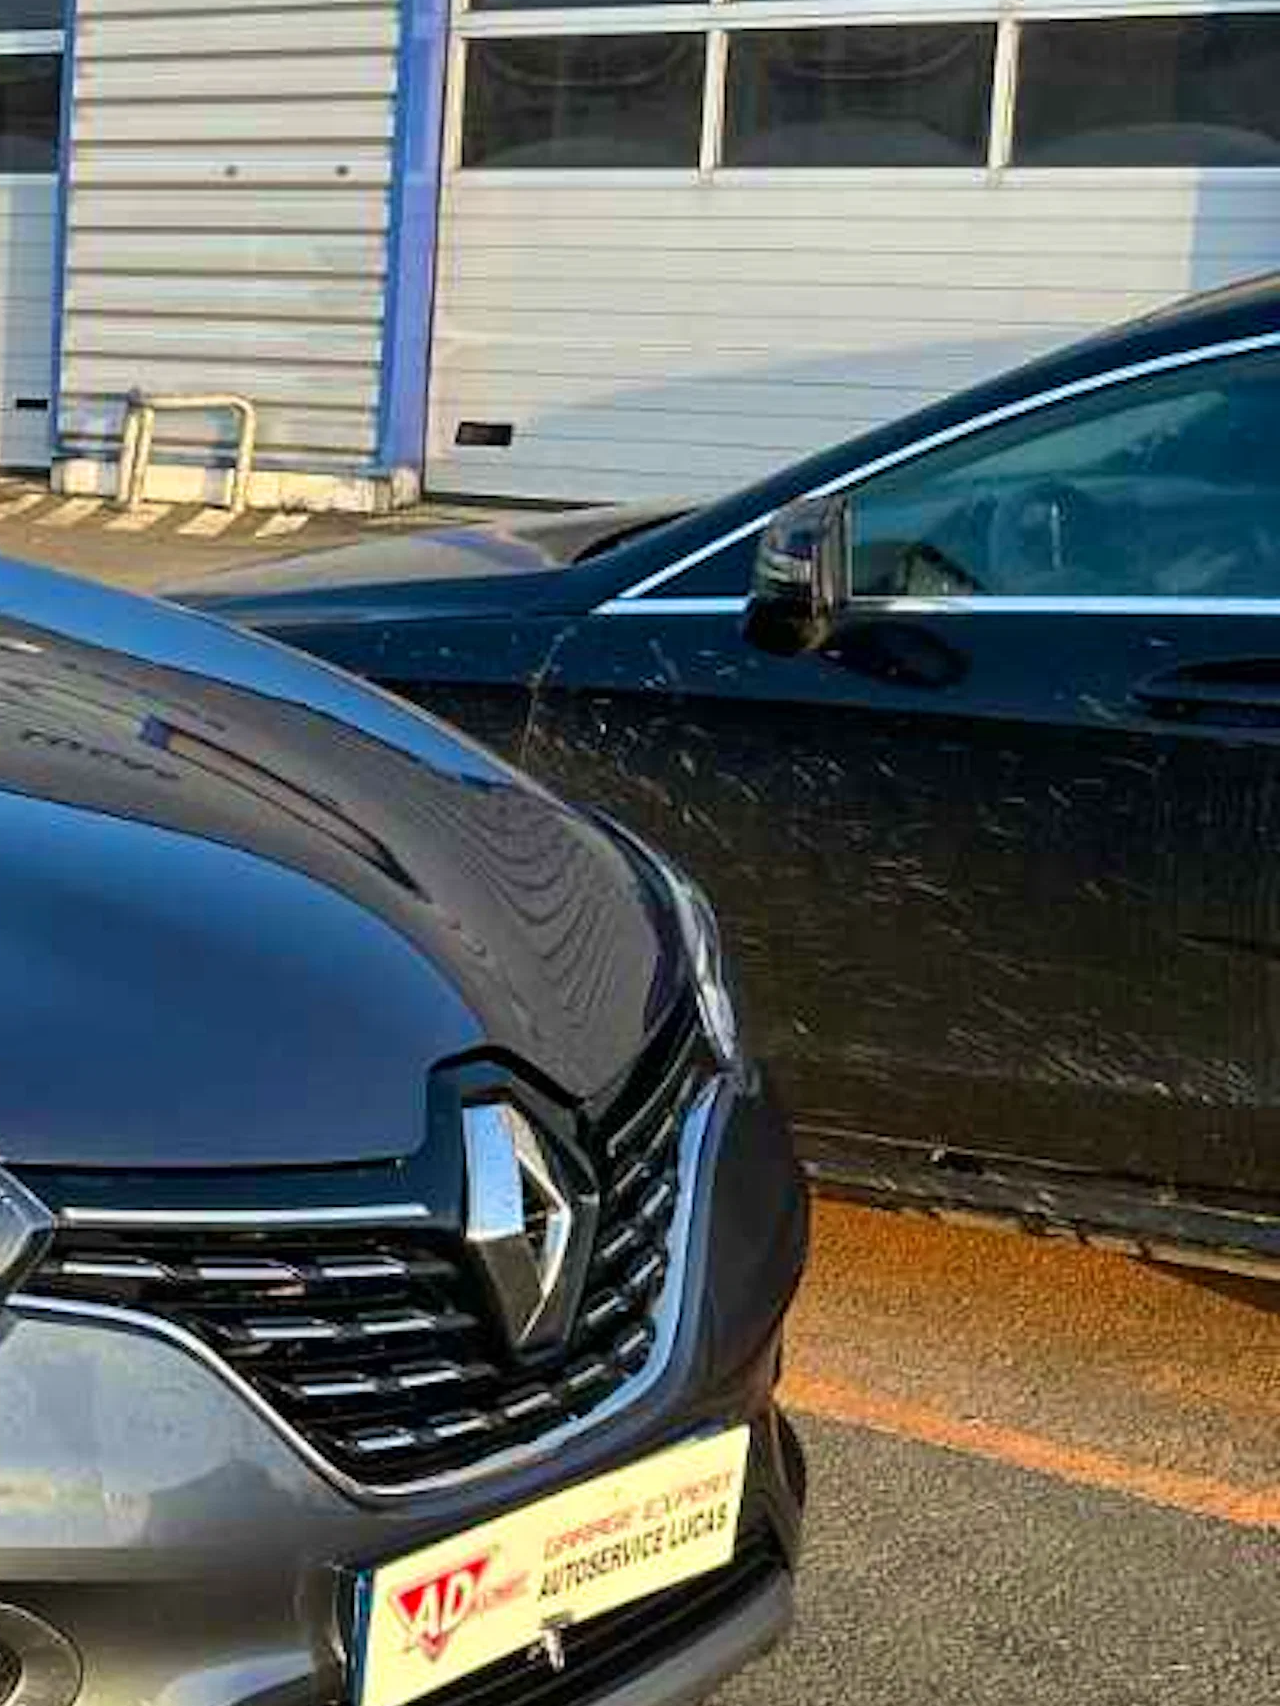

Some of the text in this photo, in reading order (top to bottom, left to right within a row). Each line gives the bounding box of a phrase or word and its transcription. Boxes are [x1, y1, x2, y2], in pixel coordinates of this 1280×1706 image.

[537, 1524, 666, 1601] AUTOSERVICE
[669, 1501, 728, 1549] LUCAS
[404, 1572, 477, 1651] AD
